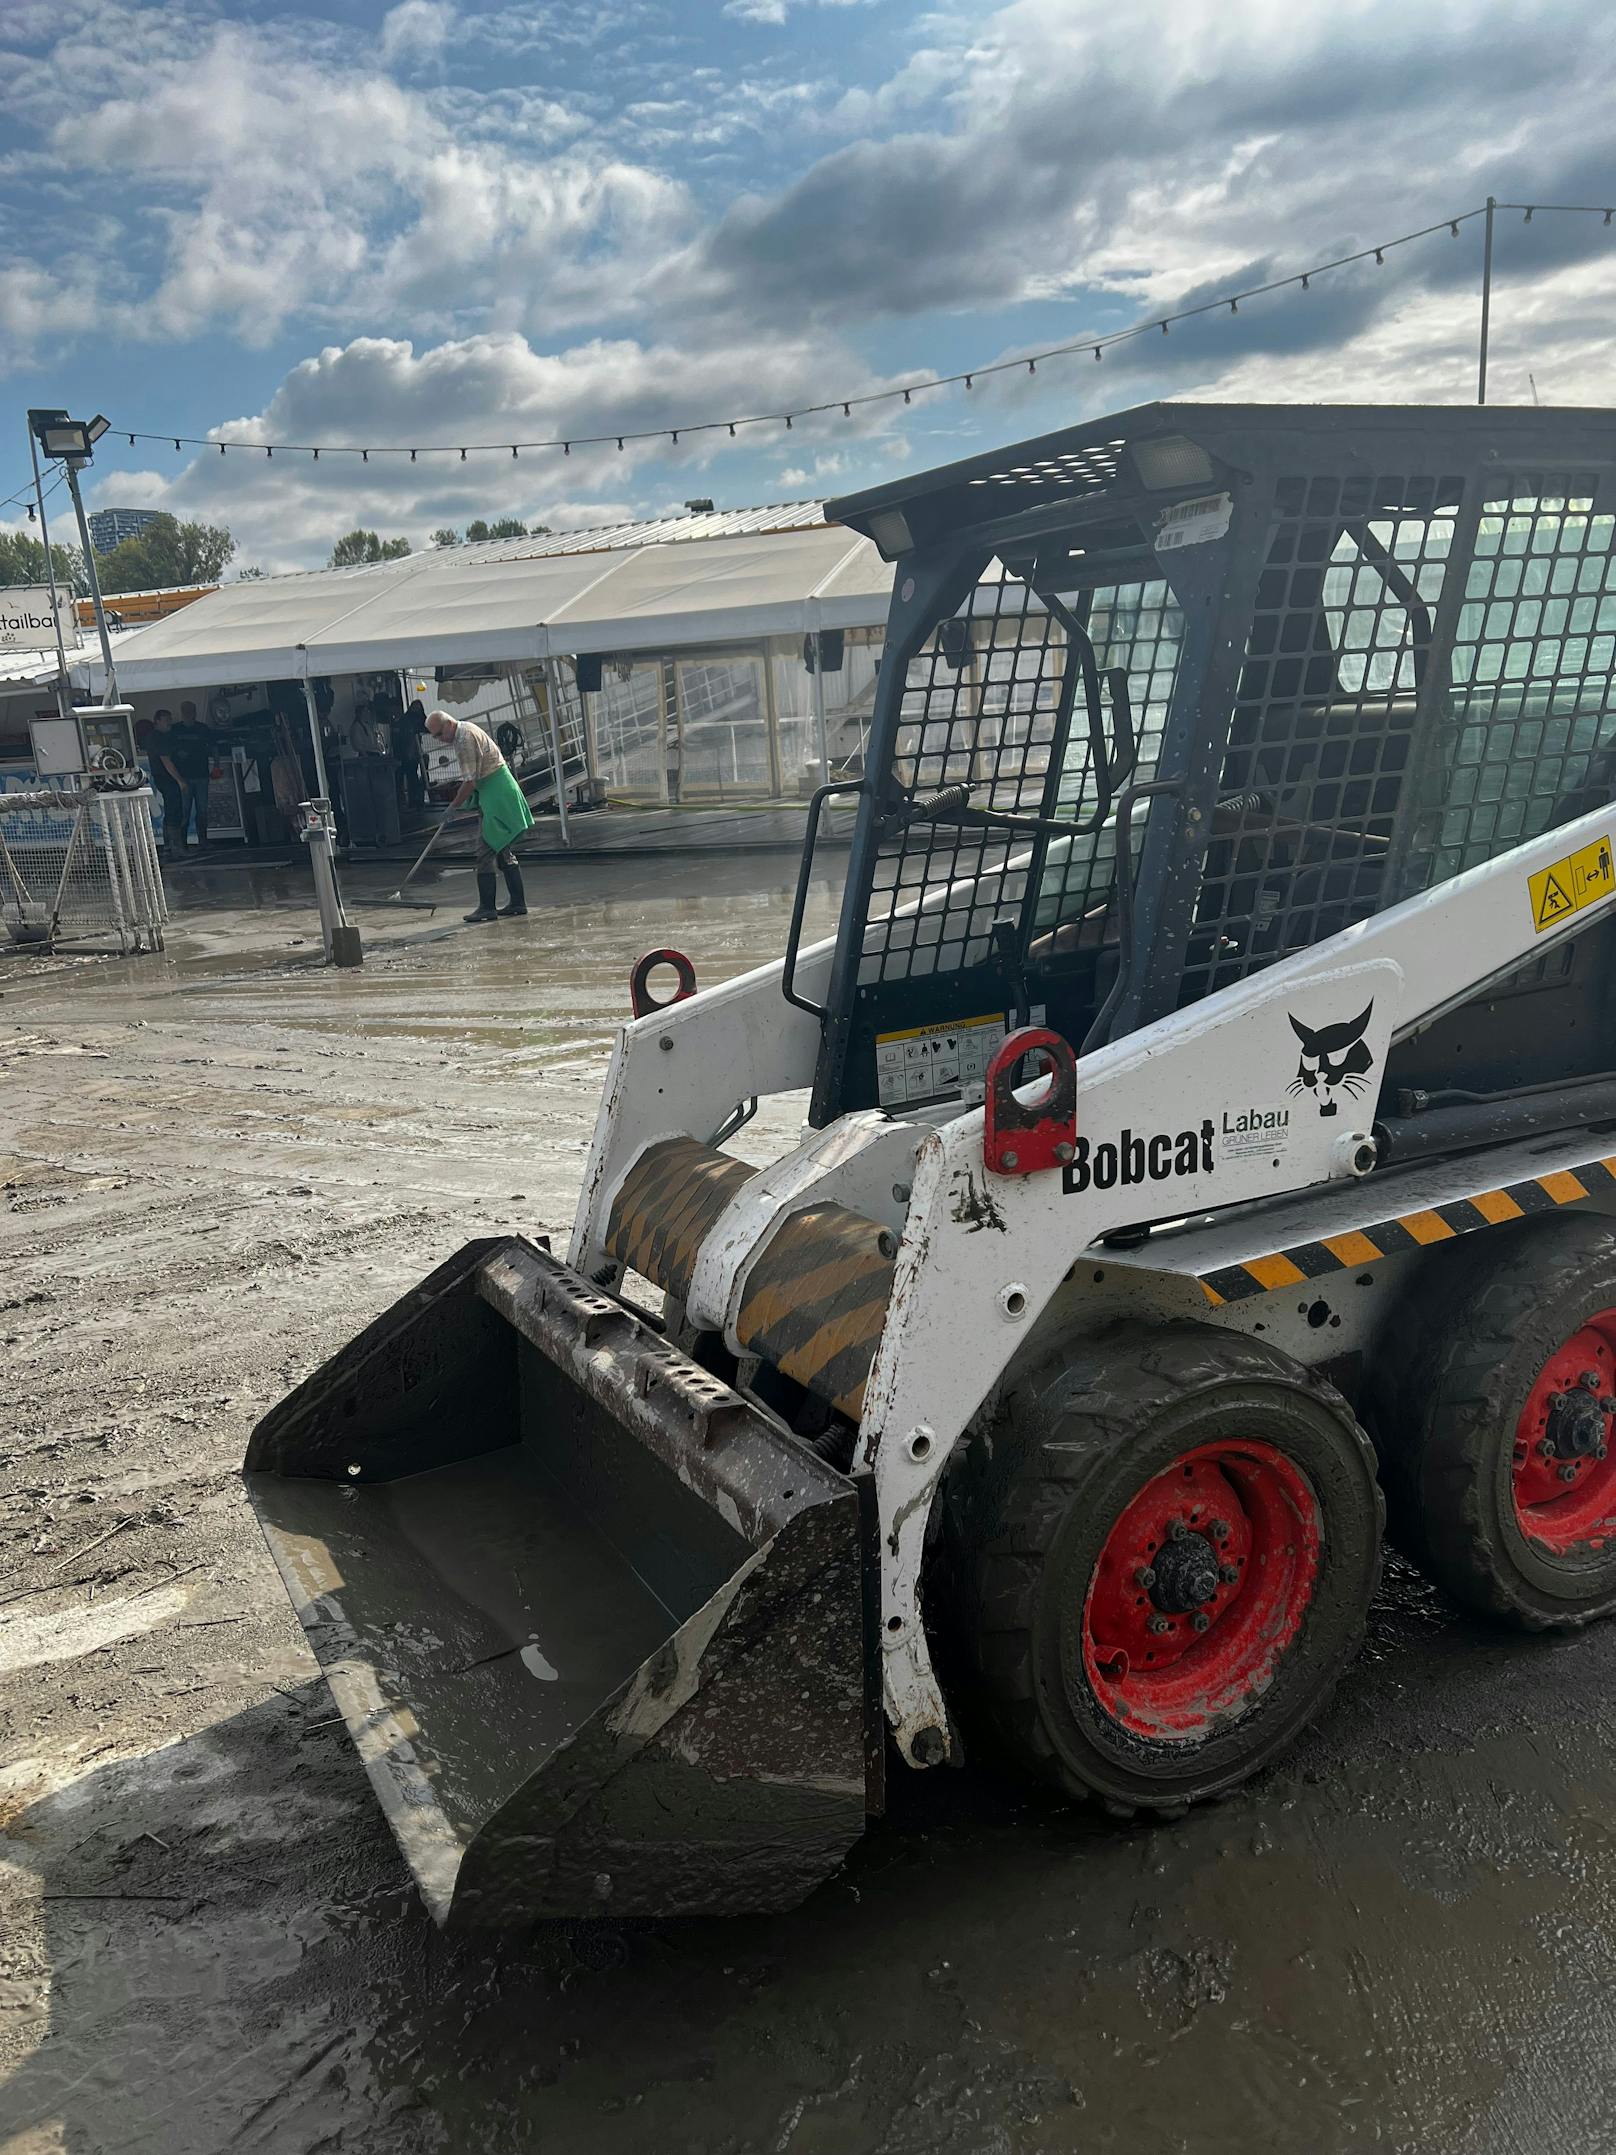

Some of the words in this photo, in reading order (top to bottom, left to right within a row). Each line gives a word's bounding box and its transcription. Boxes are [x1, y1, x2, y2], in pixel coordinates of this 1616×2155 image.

[0, 612, 57, 630] tailba
[1222, 1108, 1289, 1135] Labau
[1260, 1128, 1289, 1141] LEBEN
[1062, 1119, 1215, 1195] Bobcat
